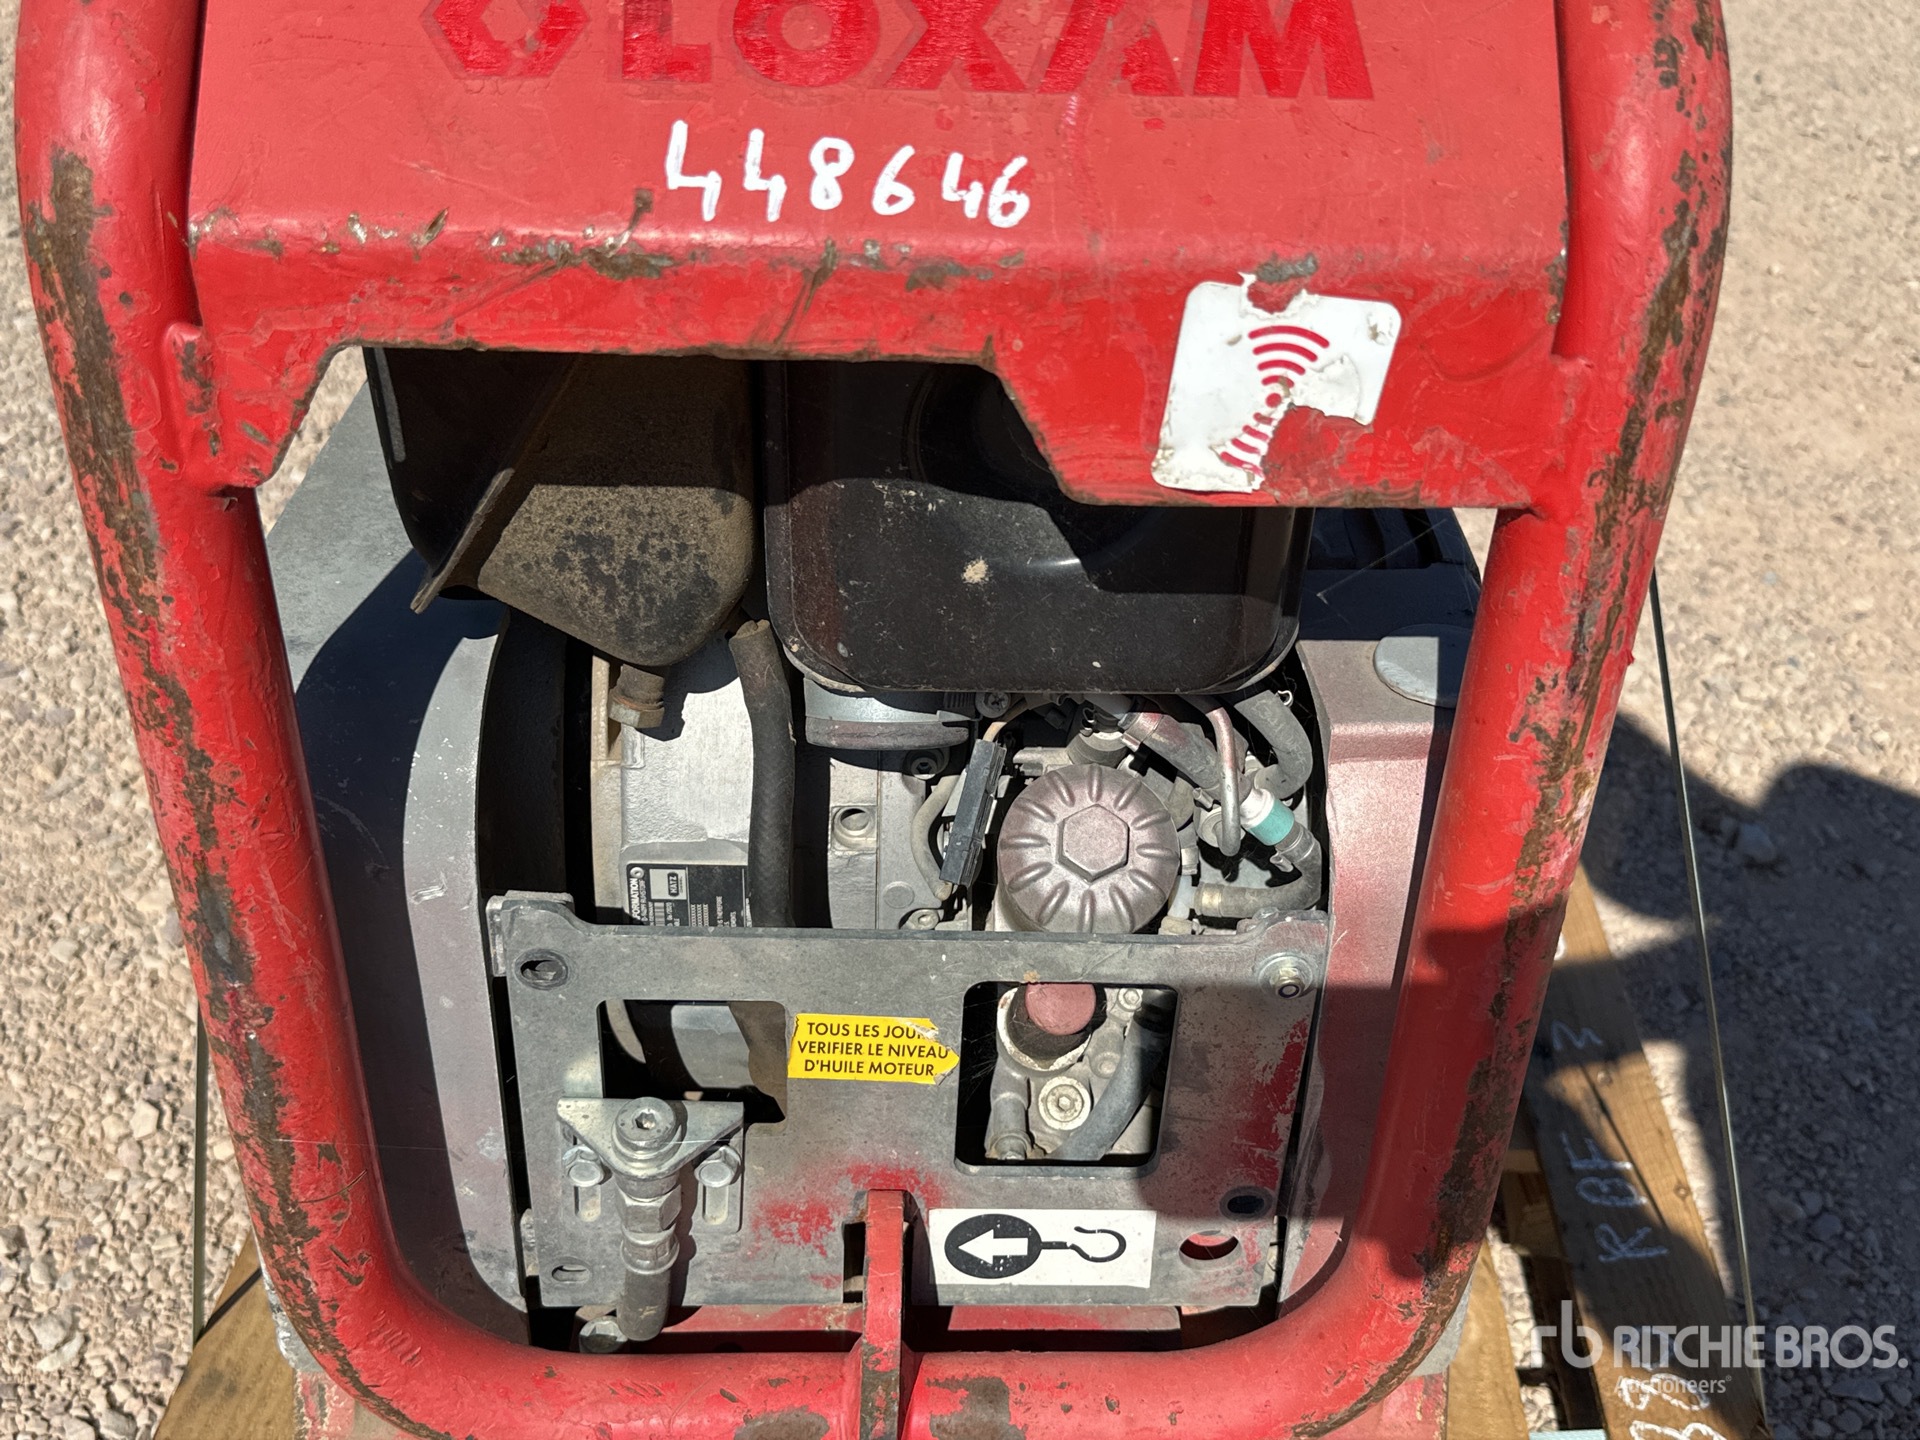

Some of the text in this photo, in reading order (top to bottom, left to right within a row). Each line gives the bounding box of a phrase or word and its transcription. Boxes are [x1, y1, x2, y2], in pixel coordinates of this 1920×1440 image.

[620, 0, 1375, 98] LOXAM
[665, 119, 1030, 228] 448646
[807, 1022, 850, 1037] TOUS
[855, 1024, 880, 1038] LES
[797, 1040, 949, 1060] VERIFIER LE NIVEAU
[804, 1059, 935, 1077] D'HUILE MOTEUR
